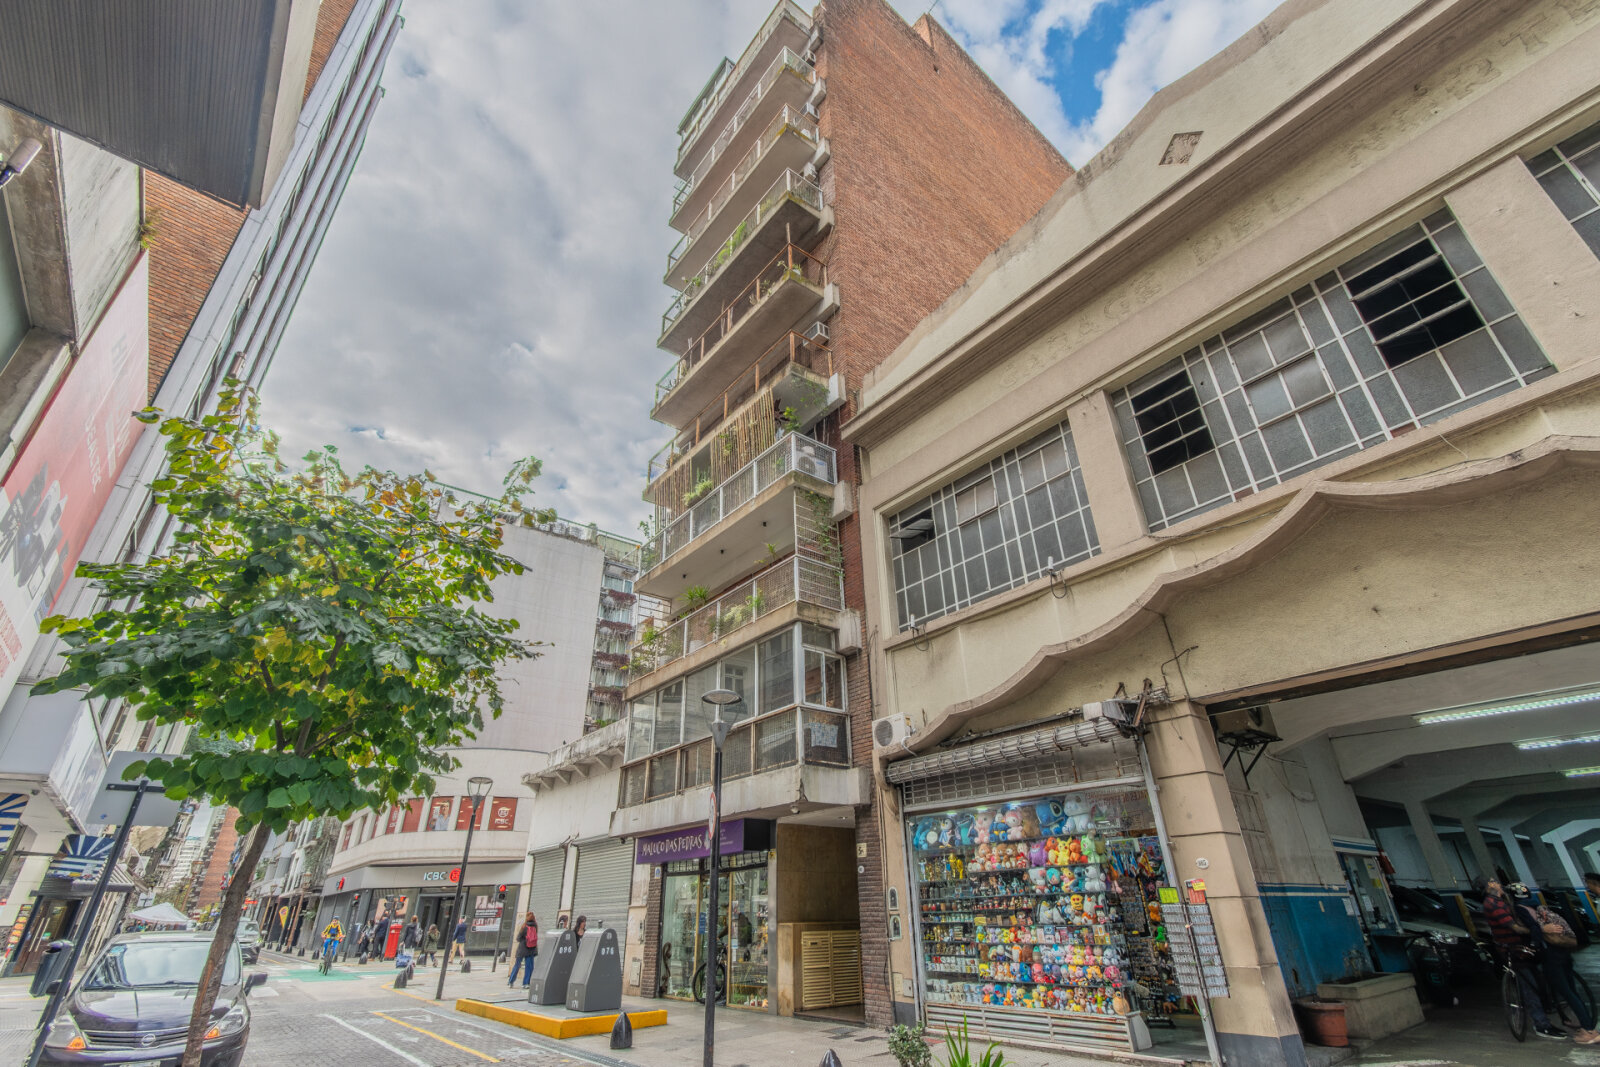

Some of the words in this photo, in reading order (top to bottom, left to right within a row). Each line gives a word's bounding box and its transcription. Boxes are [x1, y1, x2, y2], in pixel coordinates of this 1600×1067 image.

[642, 841, 664, 856] MALUCO
[677, 834, 703, 852] PEDRAS
[423, 871, 447, 881] ICBC
[559, 946, 572, 954] 096
